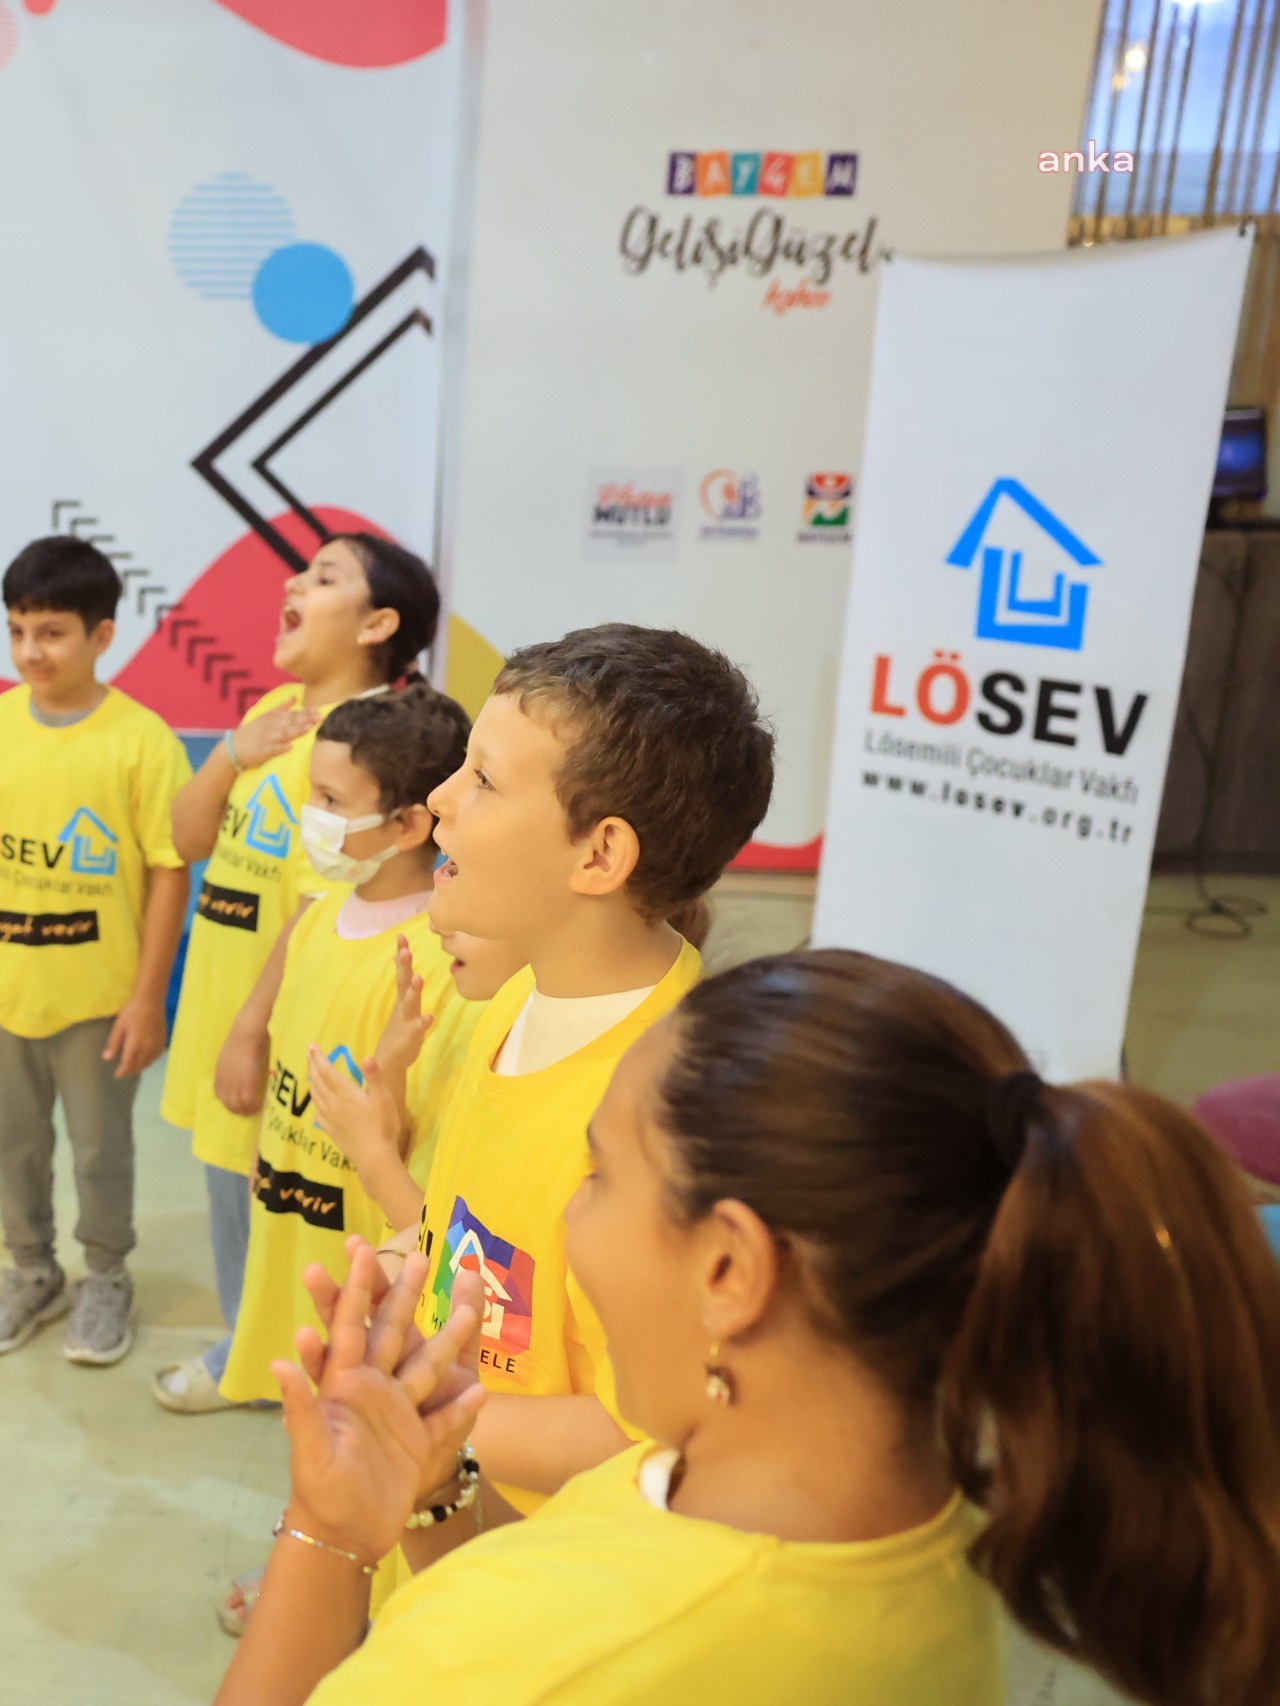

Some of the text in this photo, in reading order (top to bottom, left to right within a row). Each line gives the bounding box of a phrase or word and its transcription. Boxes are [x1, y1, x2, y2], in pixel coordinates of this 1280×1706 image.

[672, 154, 854, 193] BAYGEM
[870, 648, 1149, 757] LÖSEV
[864, 730, 1139, 805] Lösemili Çocuklar Vakfı
[862, 771, 1133, 843] www.losev.org.tr
[321, 1141, 357, 1172] Vak
